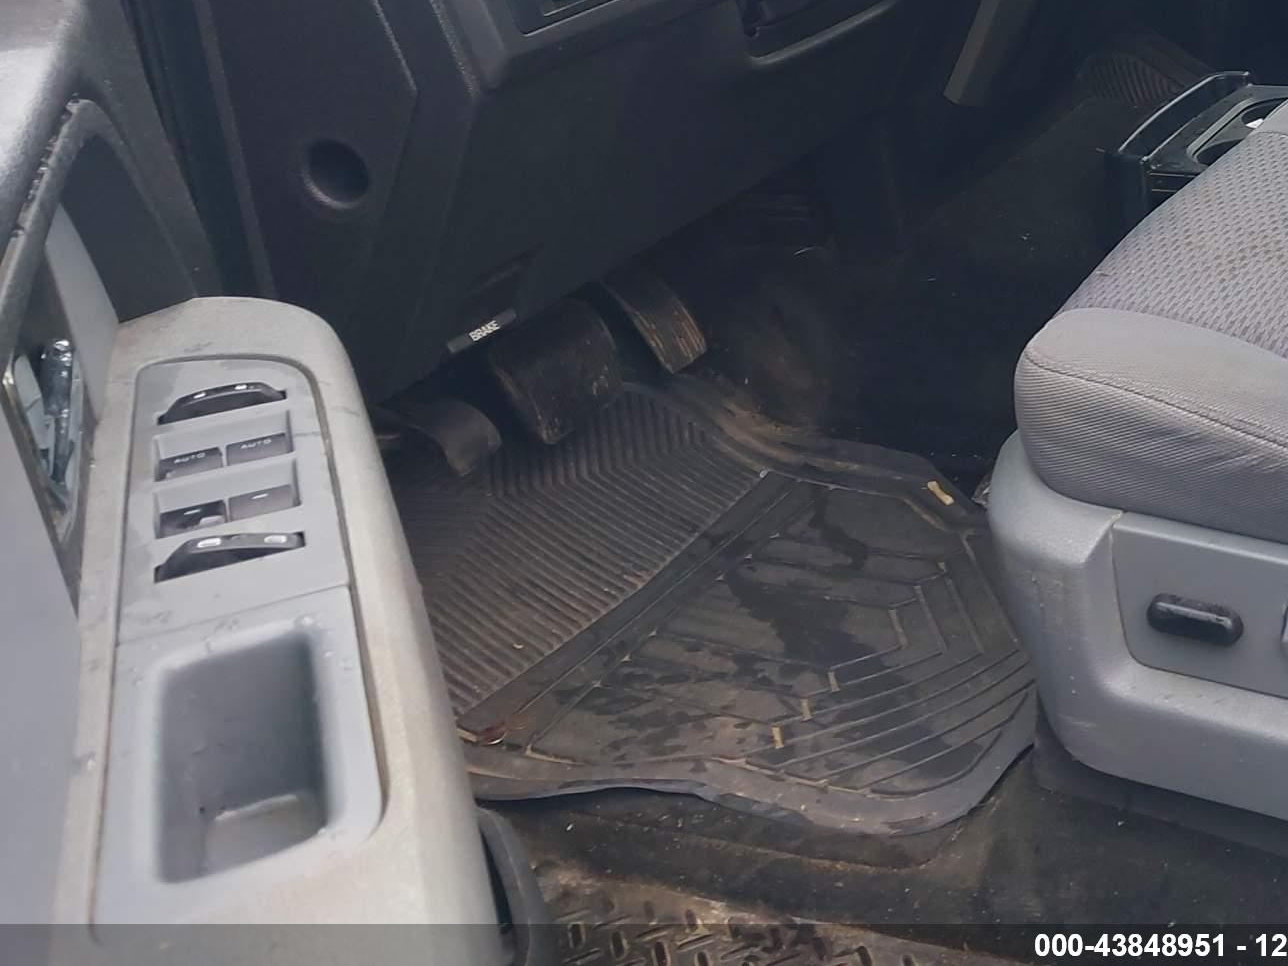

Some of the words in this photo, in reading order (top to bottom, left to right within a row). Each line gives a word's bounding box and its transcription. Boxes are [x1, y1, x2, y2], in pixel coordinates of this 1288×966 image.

[468, 320, 501, 342] BRAKE
[240, 438, 272, 450] AUTO
[173, 452, 206, 464] AUTO
